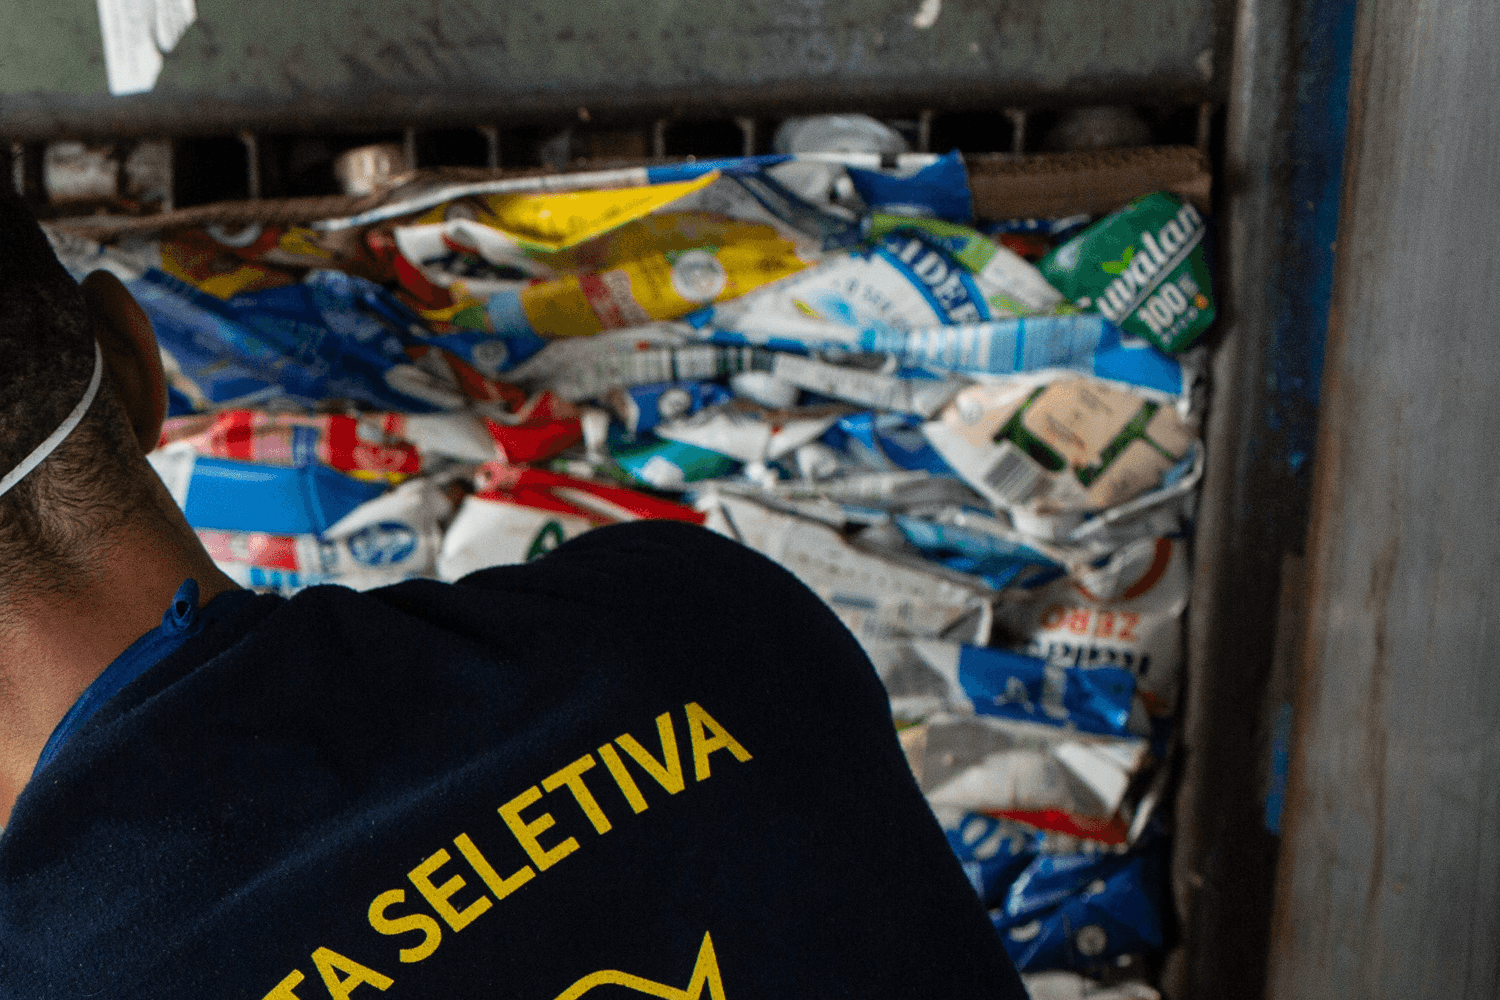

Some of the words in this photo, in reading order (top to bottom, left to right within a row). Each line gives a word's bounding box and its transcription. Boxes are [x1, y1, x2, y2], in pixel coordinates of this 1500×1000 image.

[1079, 203, 1202, 323] uvalan
[1038, 603, 1142, 642] ZERO
[368, 702, 753, 963] SELETIVA
